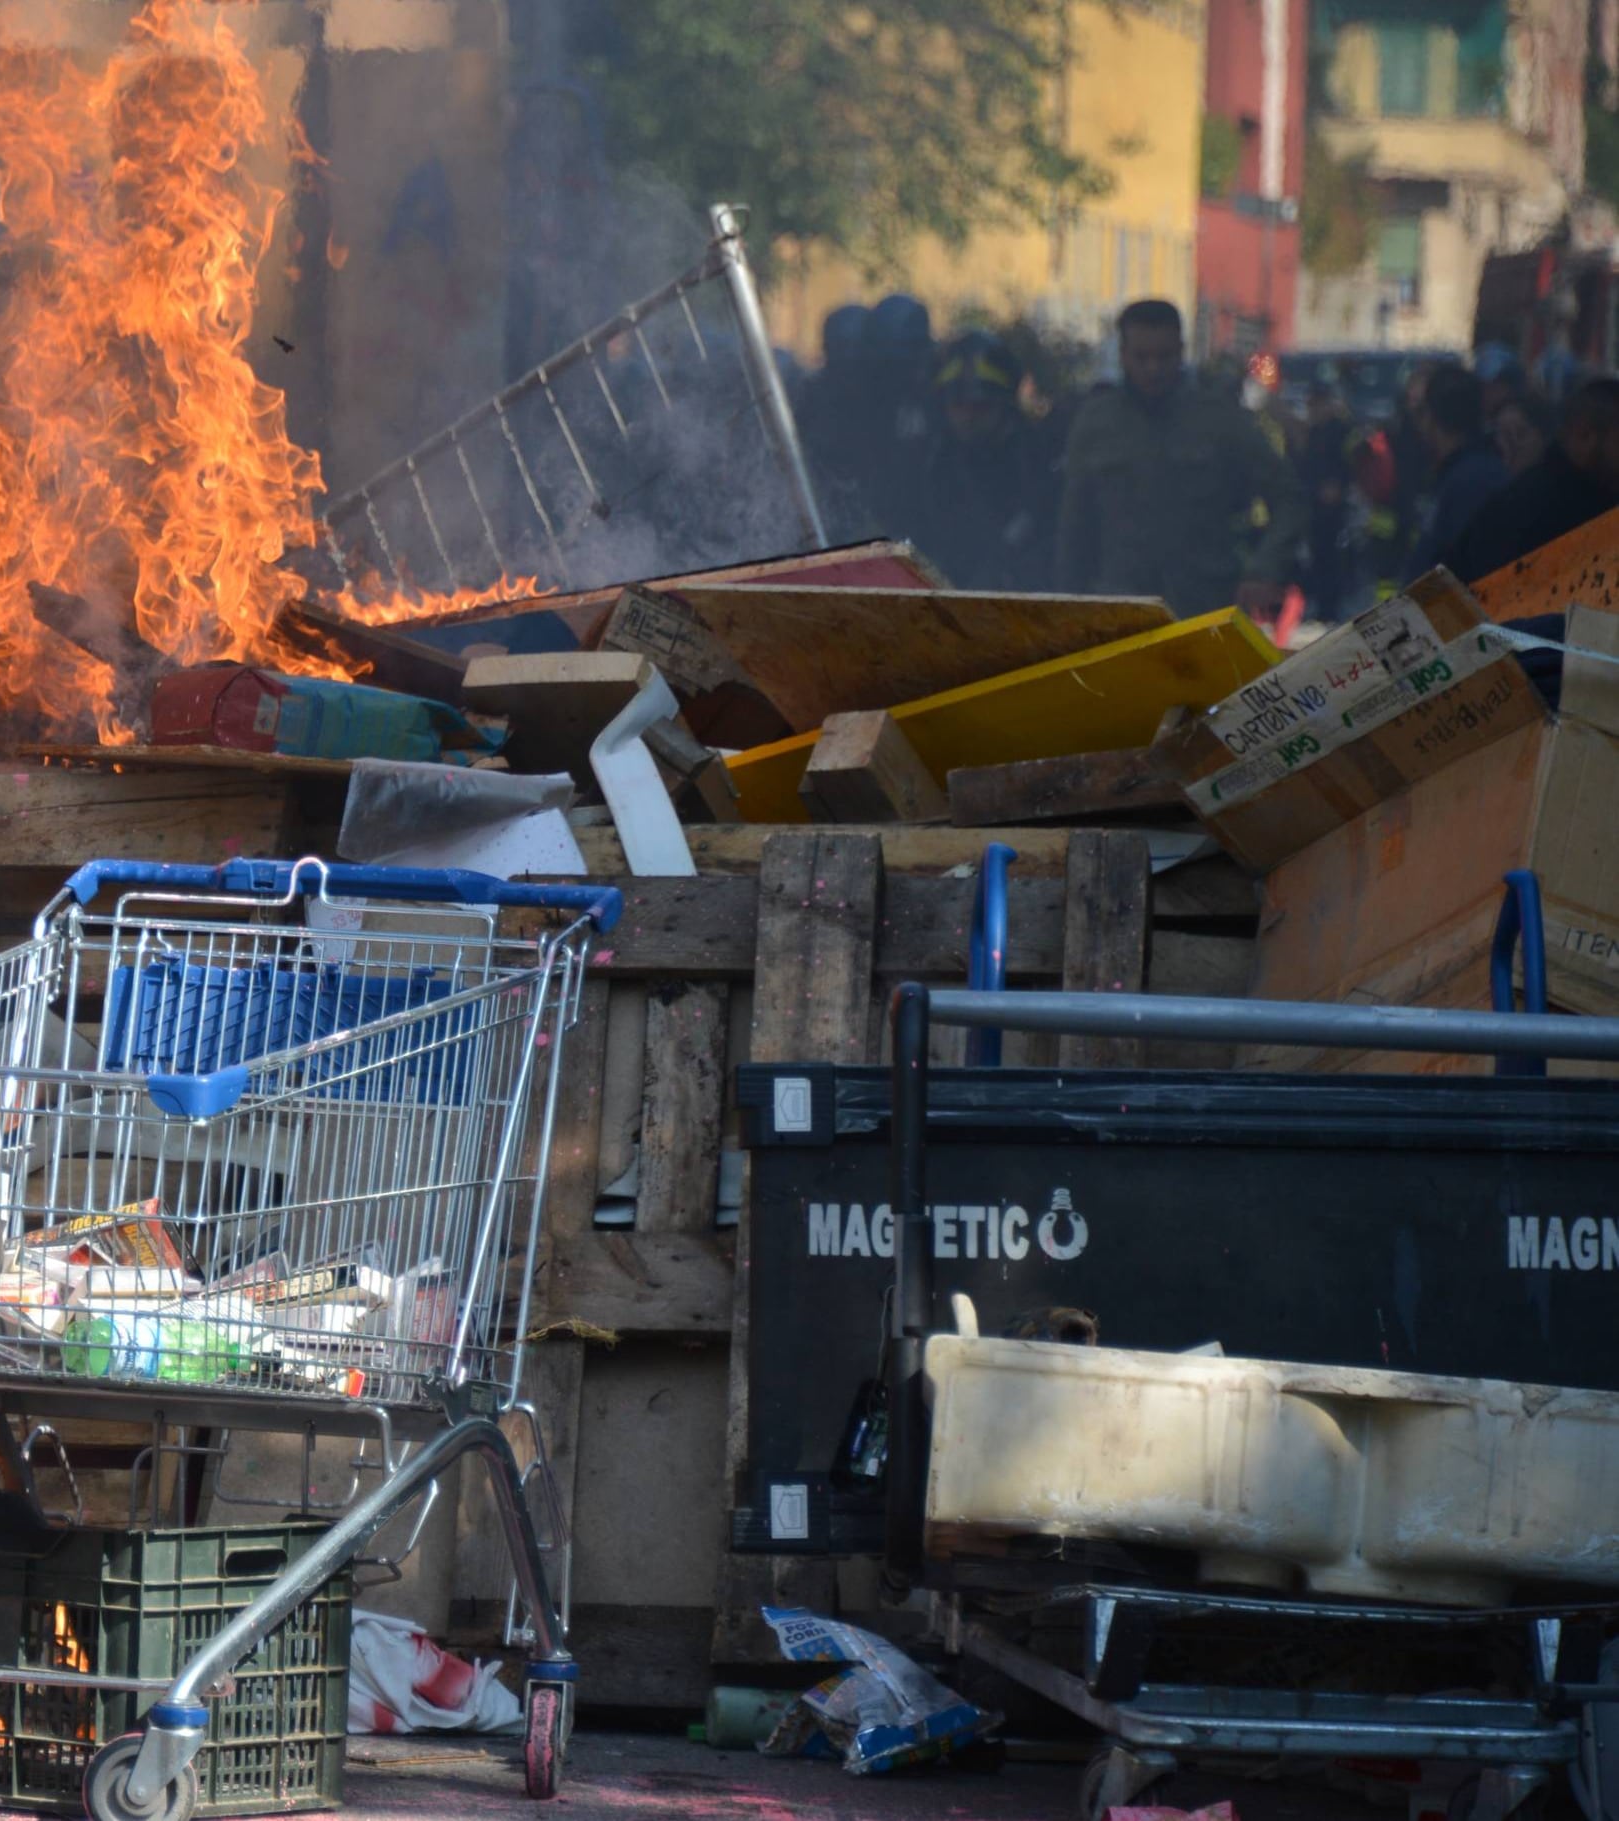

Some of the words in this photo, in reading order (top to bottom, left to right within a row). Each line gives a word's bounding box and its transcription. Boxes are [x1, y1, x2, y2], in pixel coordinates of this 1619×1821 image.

[1239, 672, 1286, 714] ITALY
[808, 1203, 1029, 1260] MAGETIC
[784, 1627, 827, 1645] CORN
[785, 1621, 816, 1635] POP
